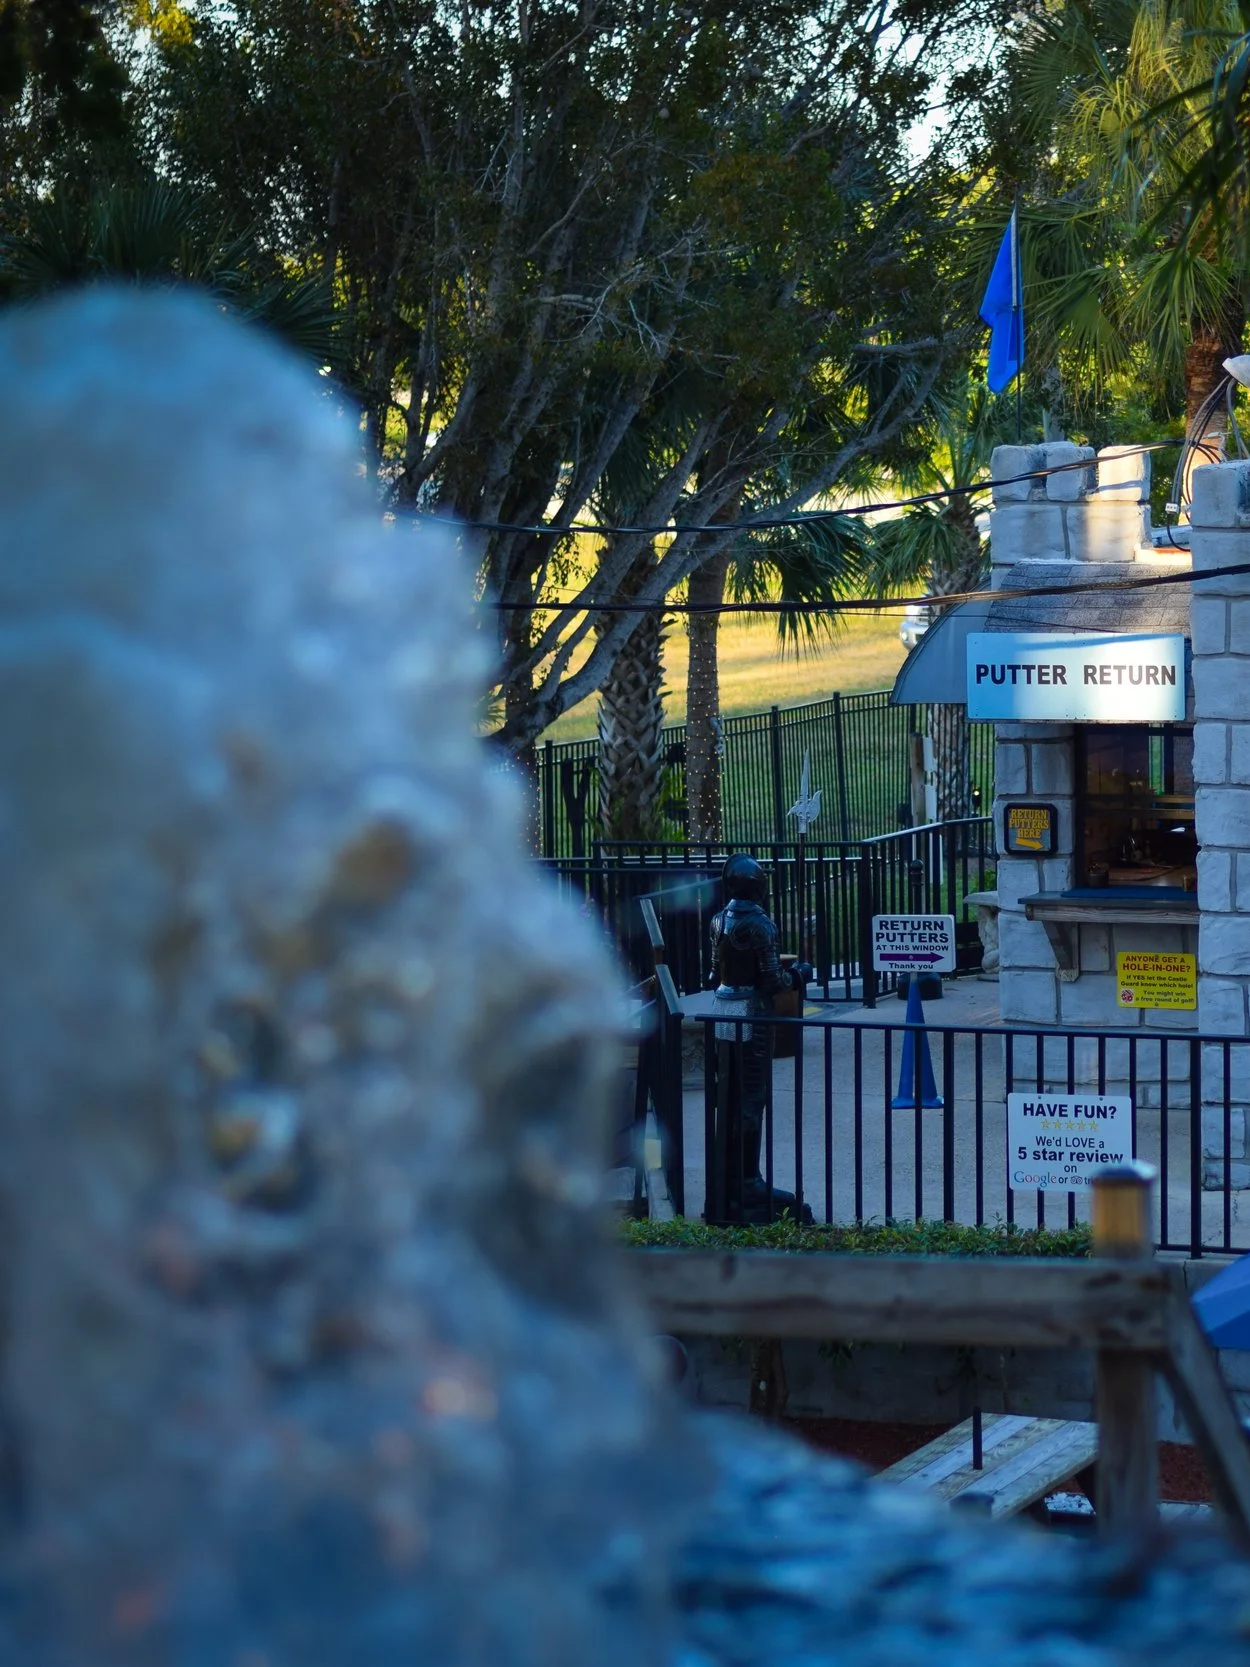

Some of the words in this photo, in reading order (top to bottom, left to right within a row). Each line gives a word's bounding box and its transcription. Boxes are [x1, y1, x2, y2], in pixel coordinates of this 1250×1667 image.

[976, 664, 1067, 685] PUTTER
[1083, 664, 1176, 685] RETURN
[1011, 809, 1047, 819] RETURN
[1008, 818, 1049, 829] PUTTERS
[1018, 829, 1041, 838] HERE
[879, 920, 944, 930] RETURN
[875, 932, 949, 943] PUTTERS
[912, 944, 949, 952] WINDOW
[1122, 963, 1191, 972] HOLE-IN-ONE?
[1023, 1103, 1068, 1118] HAVE
[1074, 1104, 1117, 1119] FUN?
[1035, 1136, 1062, 1147] We'd
[1065, 1137, 1096, 1149] LOVE
[1098, 1140, 1105, 1149] a
[1018, 1146, 1028, 1160] 5
[1032, 1147, 1065, 1162] star
[1069, 1149, 1124, 1164] review
[1064, 1164, 1078, 1173] on
[1014, 1171, 1057, 1187] Google
[1058, 1176, 1068, 1184] or
